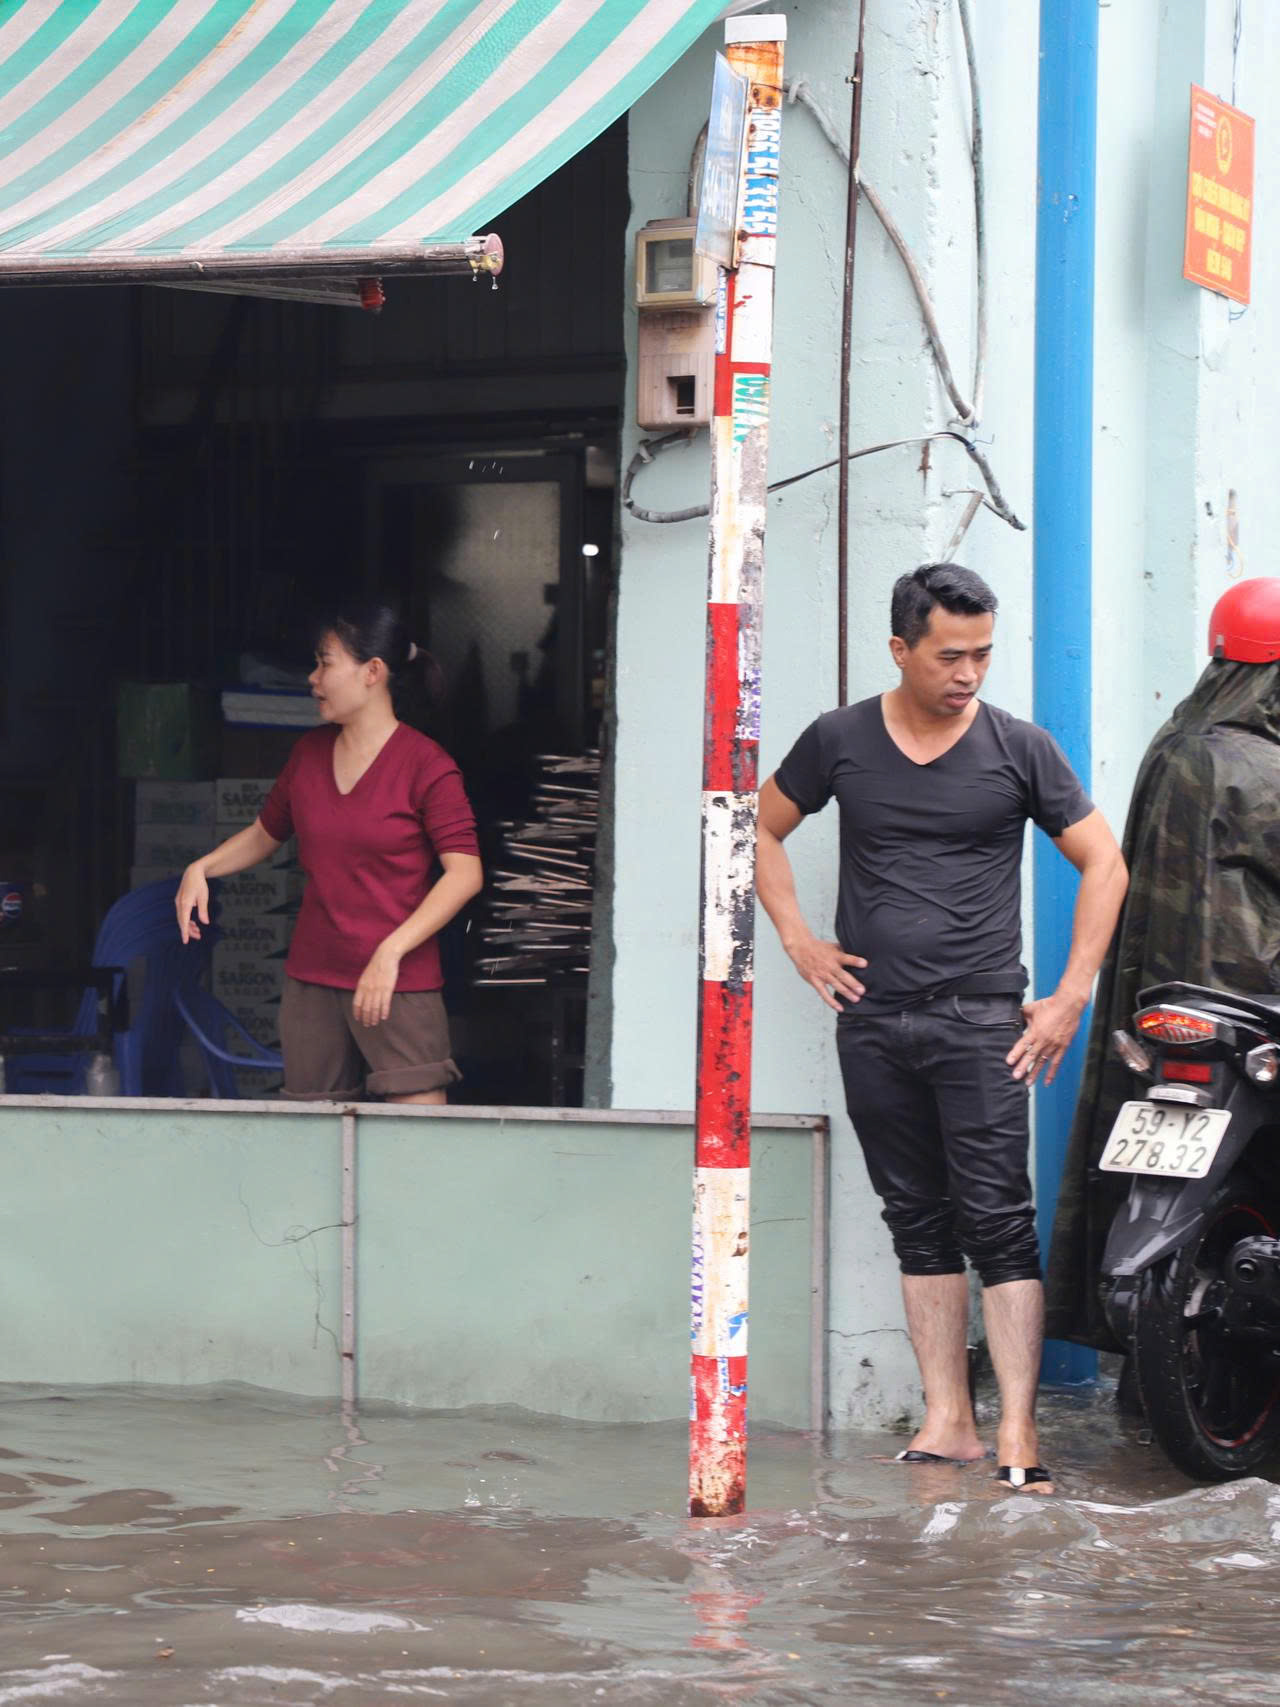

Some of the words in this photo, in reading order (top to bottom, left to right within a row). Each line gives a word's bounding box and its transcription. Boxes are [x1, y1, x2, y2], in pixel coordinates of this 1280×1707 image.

[223, 792, 271, 807] SAIGO
[1131, 1108, 1210, 1142] 59-Y2
[1110, 1139, 1207, 1172] 278.32
